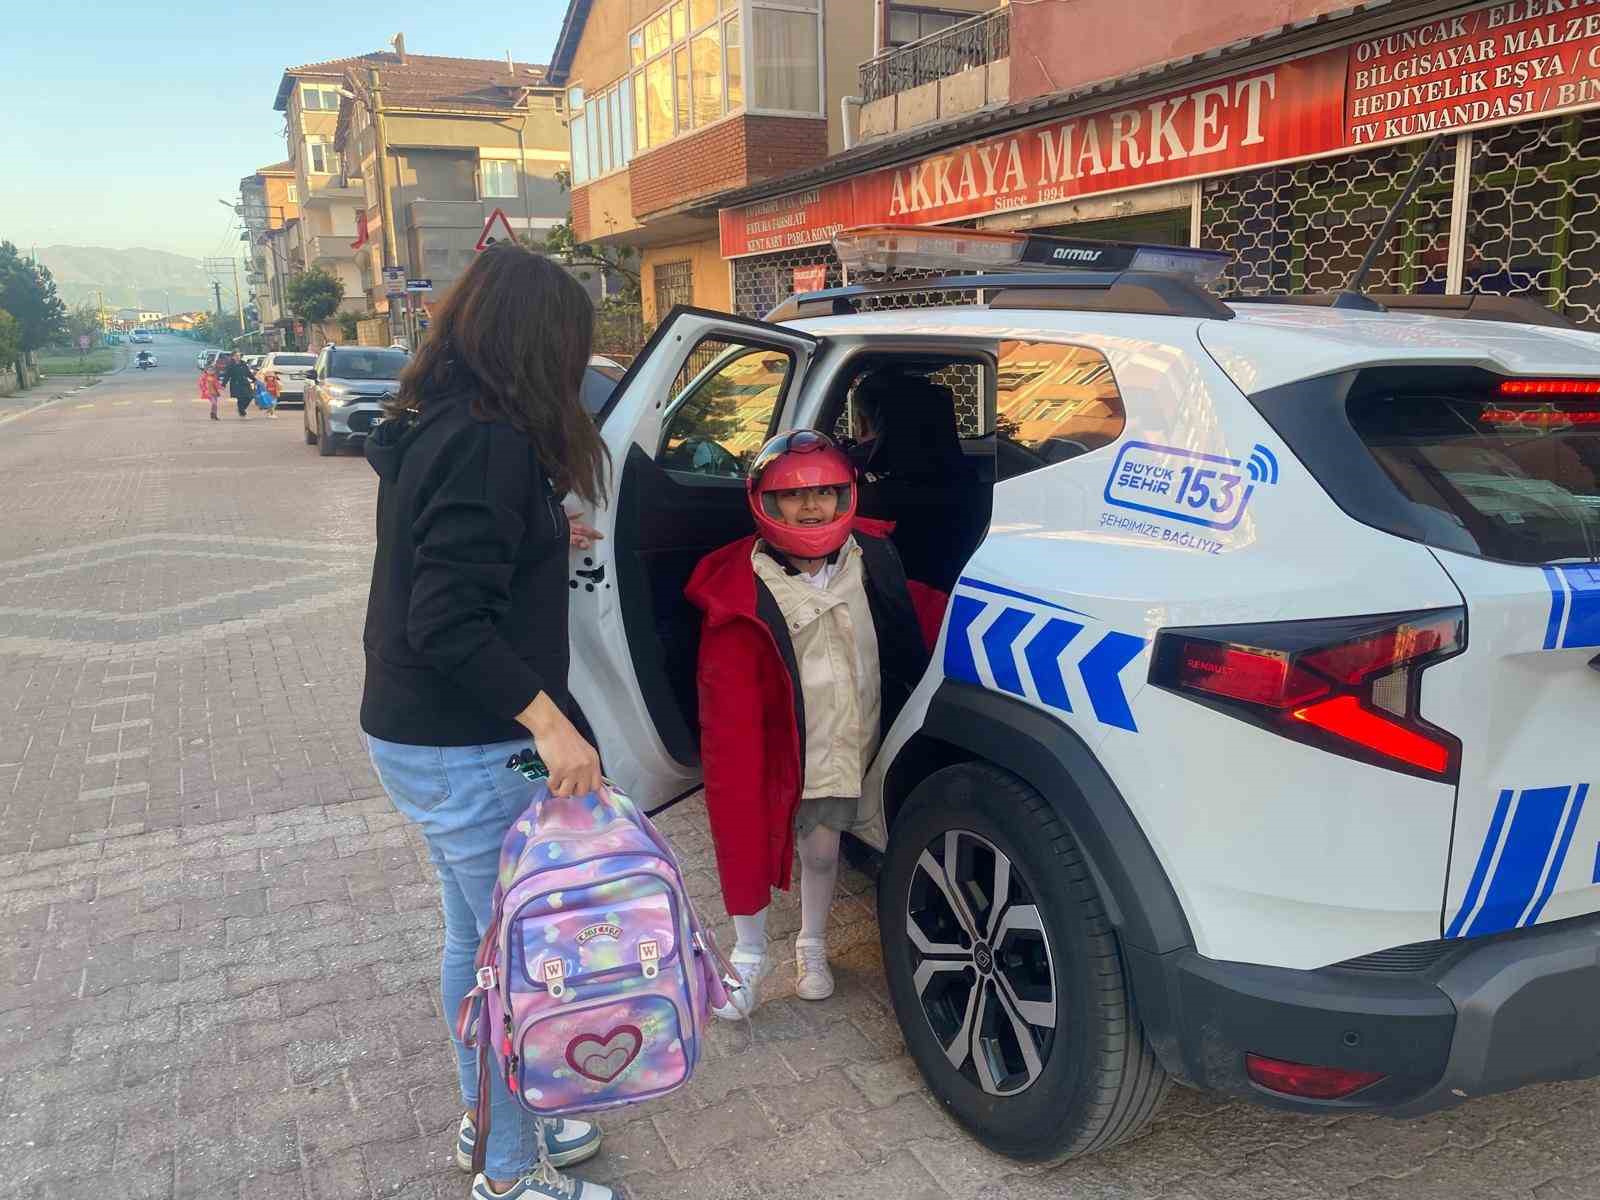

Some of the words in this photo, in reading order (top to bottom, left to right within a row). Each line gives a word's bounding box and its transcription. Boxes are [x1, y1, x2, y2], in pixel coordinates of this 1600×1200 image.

[1356, 16, 1467, 62] OYUNCAK
[1471, 13, 1481, 34] /
[1352, 69, 1488, 118] HEDİYELİK
[1494, 54, 1565, 88] EŞYA
[1570, 50, 1581, 74] /
[1355, 38, 1497, 90] BİLGİSAYAR
[1352, 123, 1380, 145] TV
[1383, 91, 1535, 138] KUMANDASI
[1540, 87, 1551, 112] /
[888, 139, 1027, 217] AKKAYA
[1037, 72, 1276, 186] MARKET
[994, 193, 1026, 211] Since
[1037, 185, 1065, 204] 1994
[1123, 461, 1174, 480] BÜYÜK
[1175, 466, 1242, 513] 153
[547, 963, 560, 976] W
[643, 945, 655, 957] W
